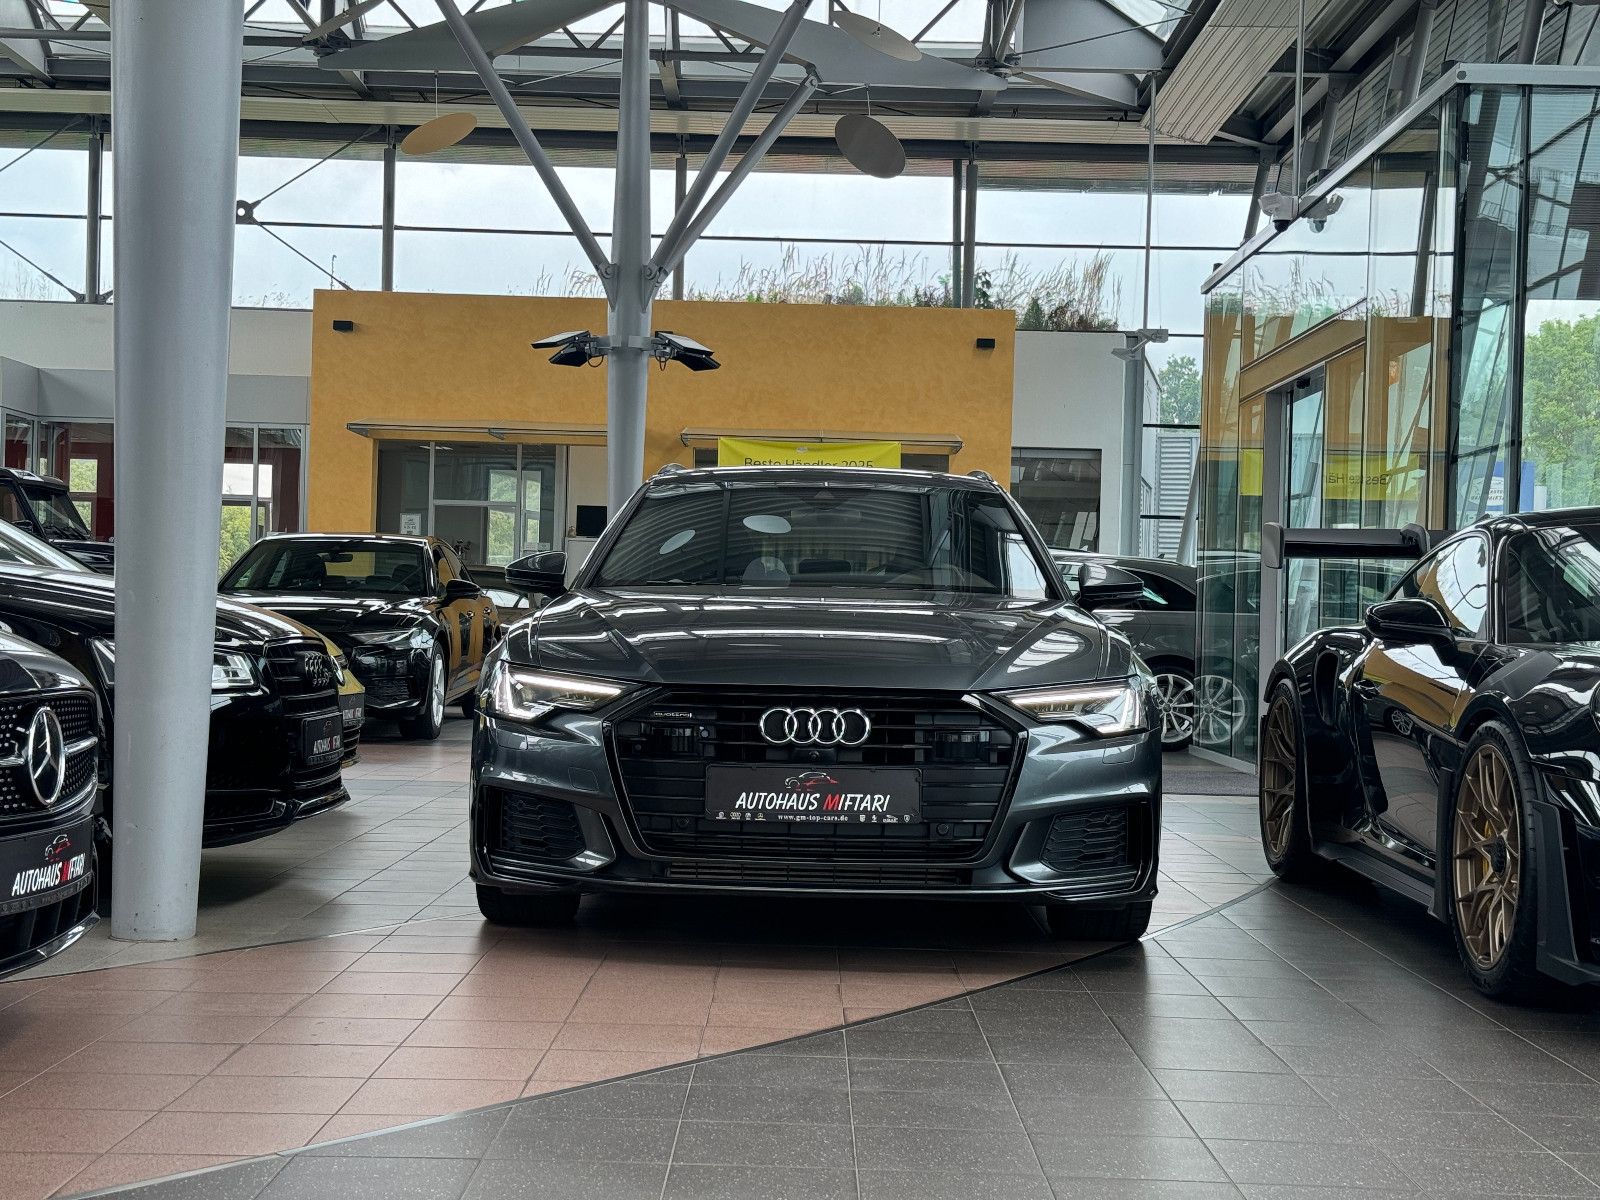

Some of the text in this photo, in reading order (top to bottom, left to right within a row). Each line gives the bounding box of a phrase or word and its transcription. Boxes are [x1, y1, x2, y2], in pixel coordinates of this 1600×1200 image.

[734, 792, 890, 812] AUTOHAUS MIFTARI
[777, 814, 848, 822] www.gm-top-cars.de
[11, 861, 62, 897] AUTOHAUS
